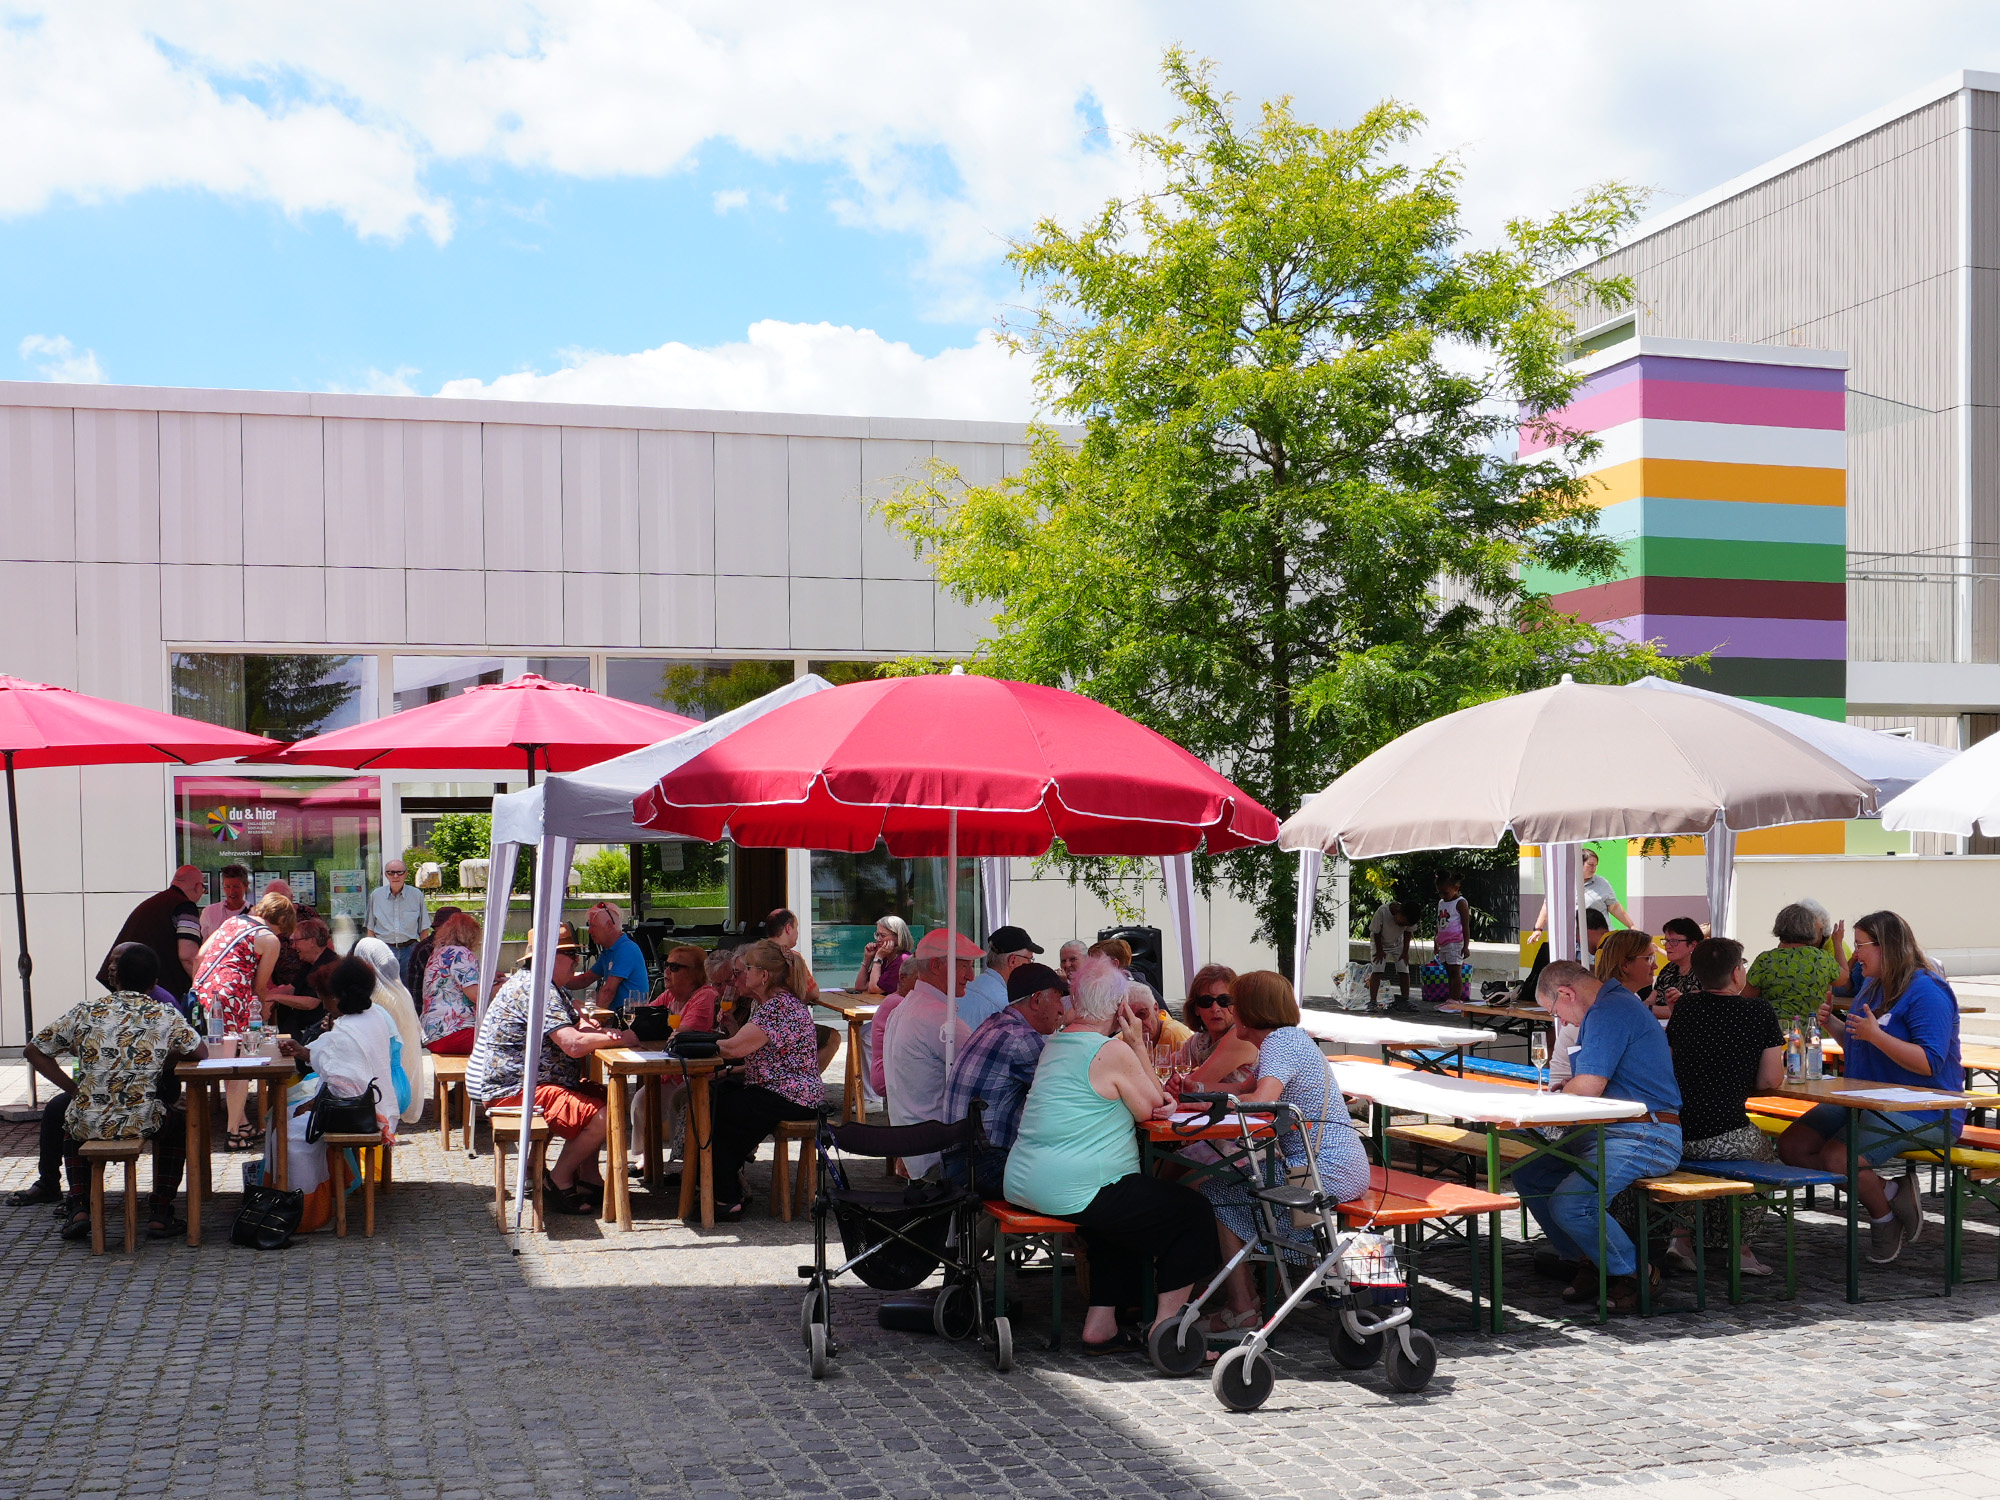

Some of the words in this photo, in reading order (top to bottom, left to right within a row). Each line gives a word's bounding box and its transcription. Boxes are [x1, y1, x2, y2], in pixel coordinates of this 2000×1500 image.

[229, 807, 243, 820] du
[244, 808, 254, 820] &
[255, 807, 278, 820] hier
